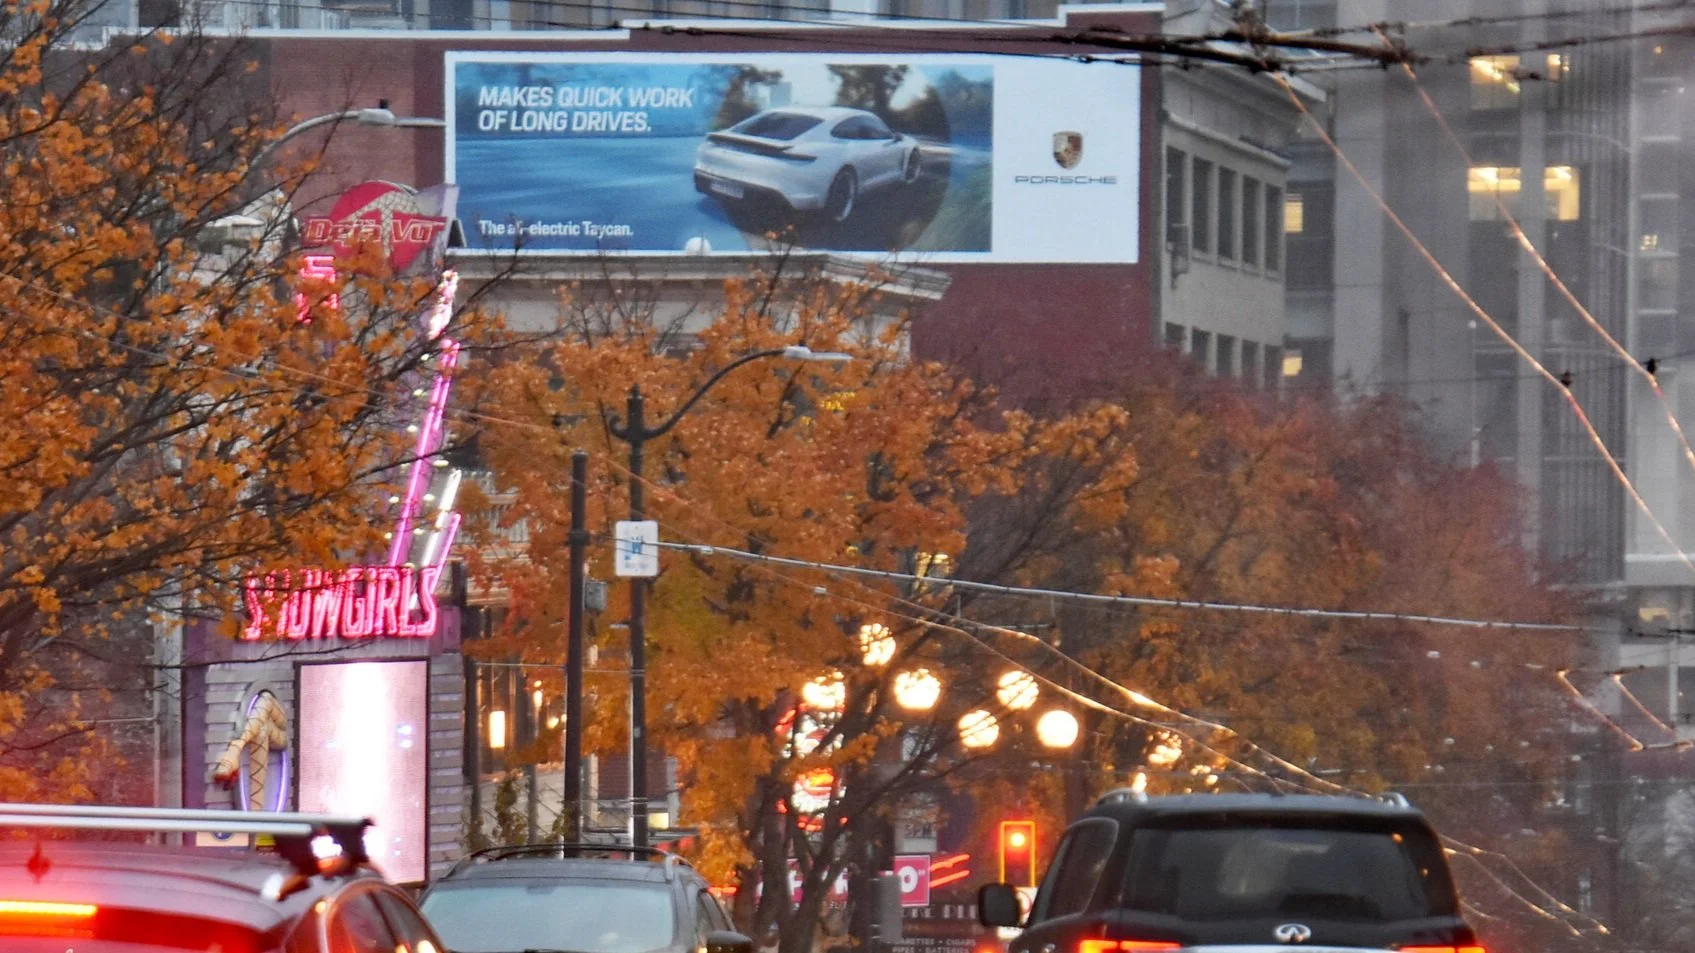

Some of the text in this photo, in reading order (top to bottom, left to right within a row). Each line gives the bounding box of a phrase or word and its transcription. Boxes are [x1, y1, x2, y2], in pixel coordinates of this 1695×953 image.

[479, 86, 695, 108] MAKES QUICK WORK
[478, 110, 652, 132] OF LONG DRIVES.
[1014, 175, 1117, 184] PORSCHE
[479, 219, 505, 236] The
[582, 221, 634, 239] Taycan.
